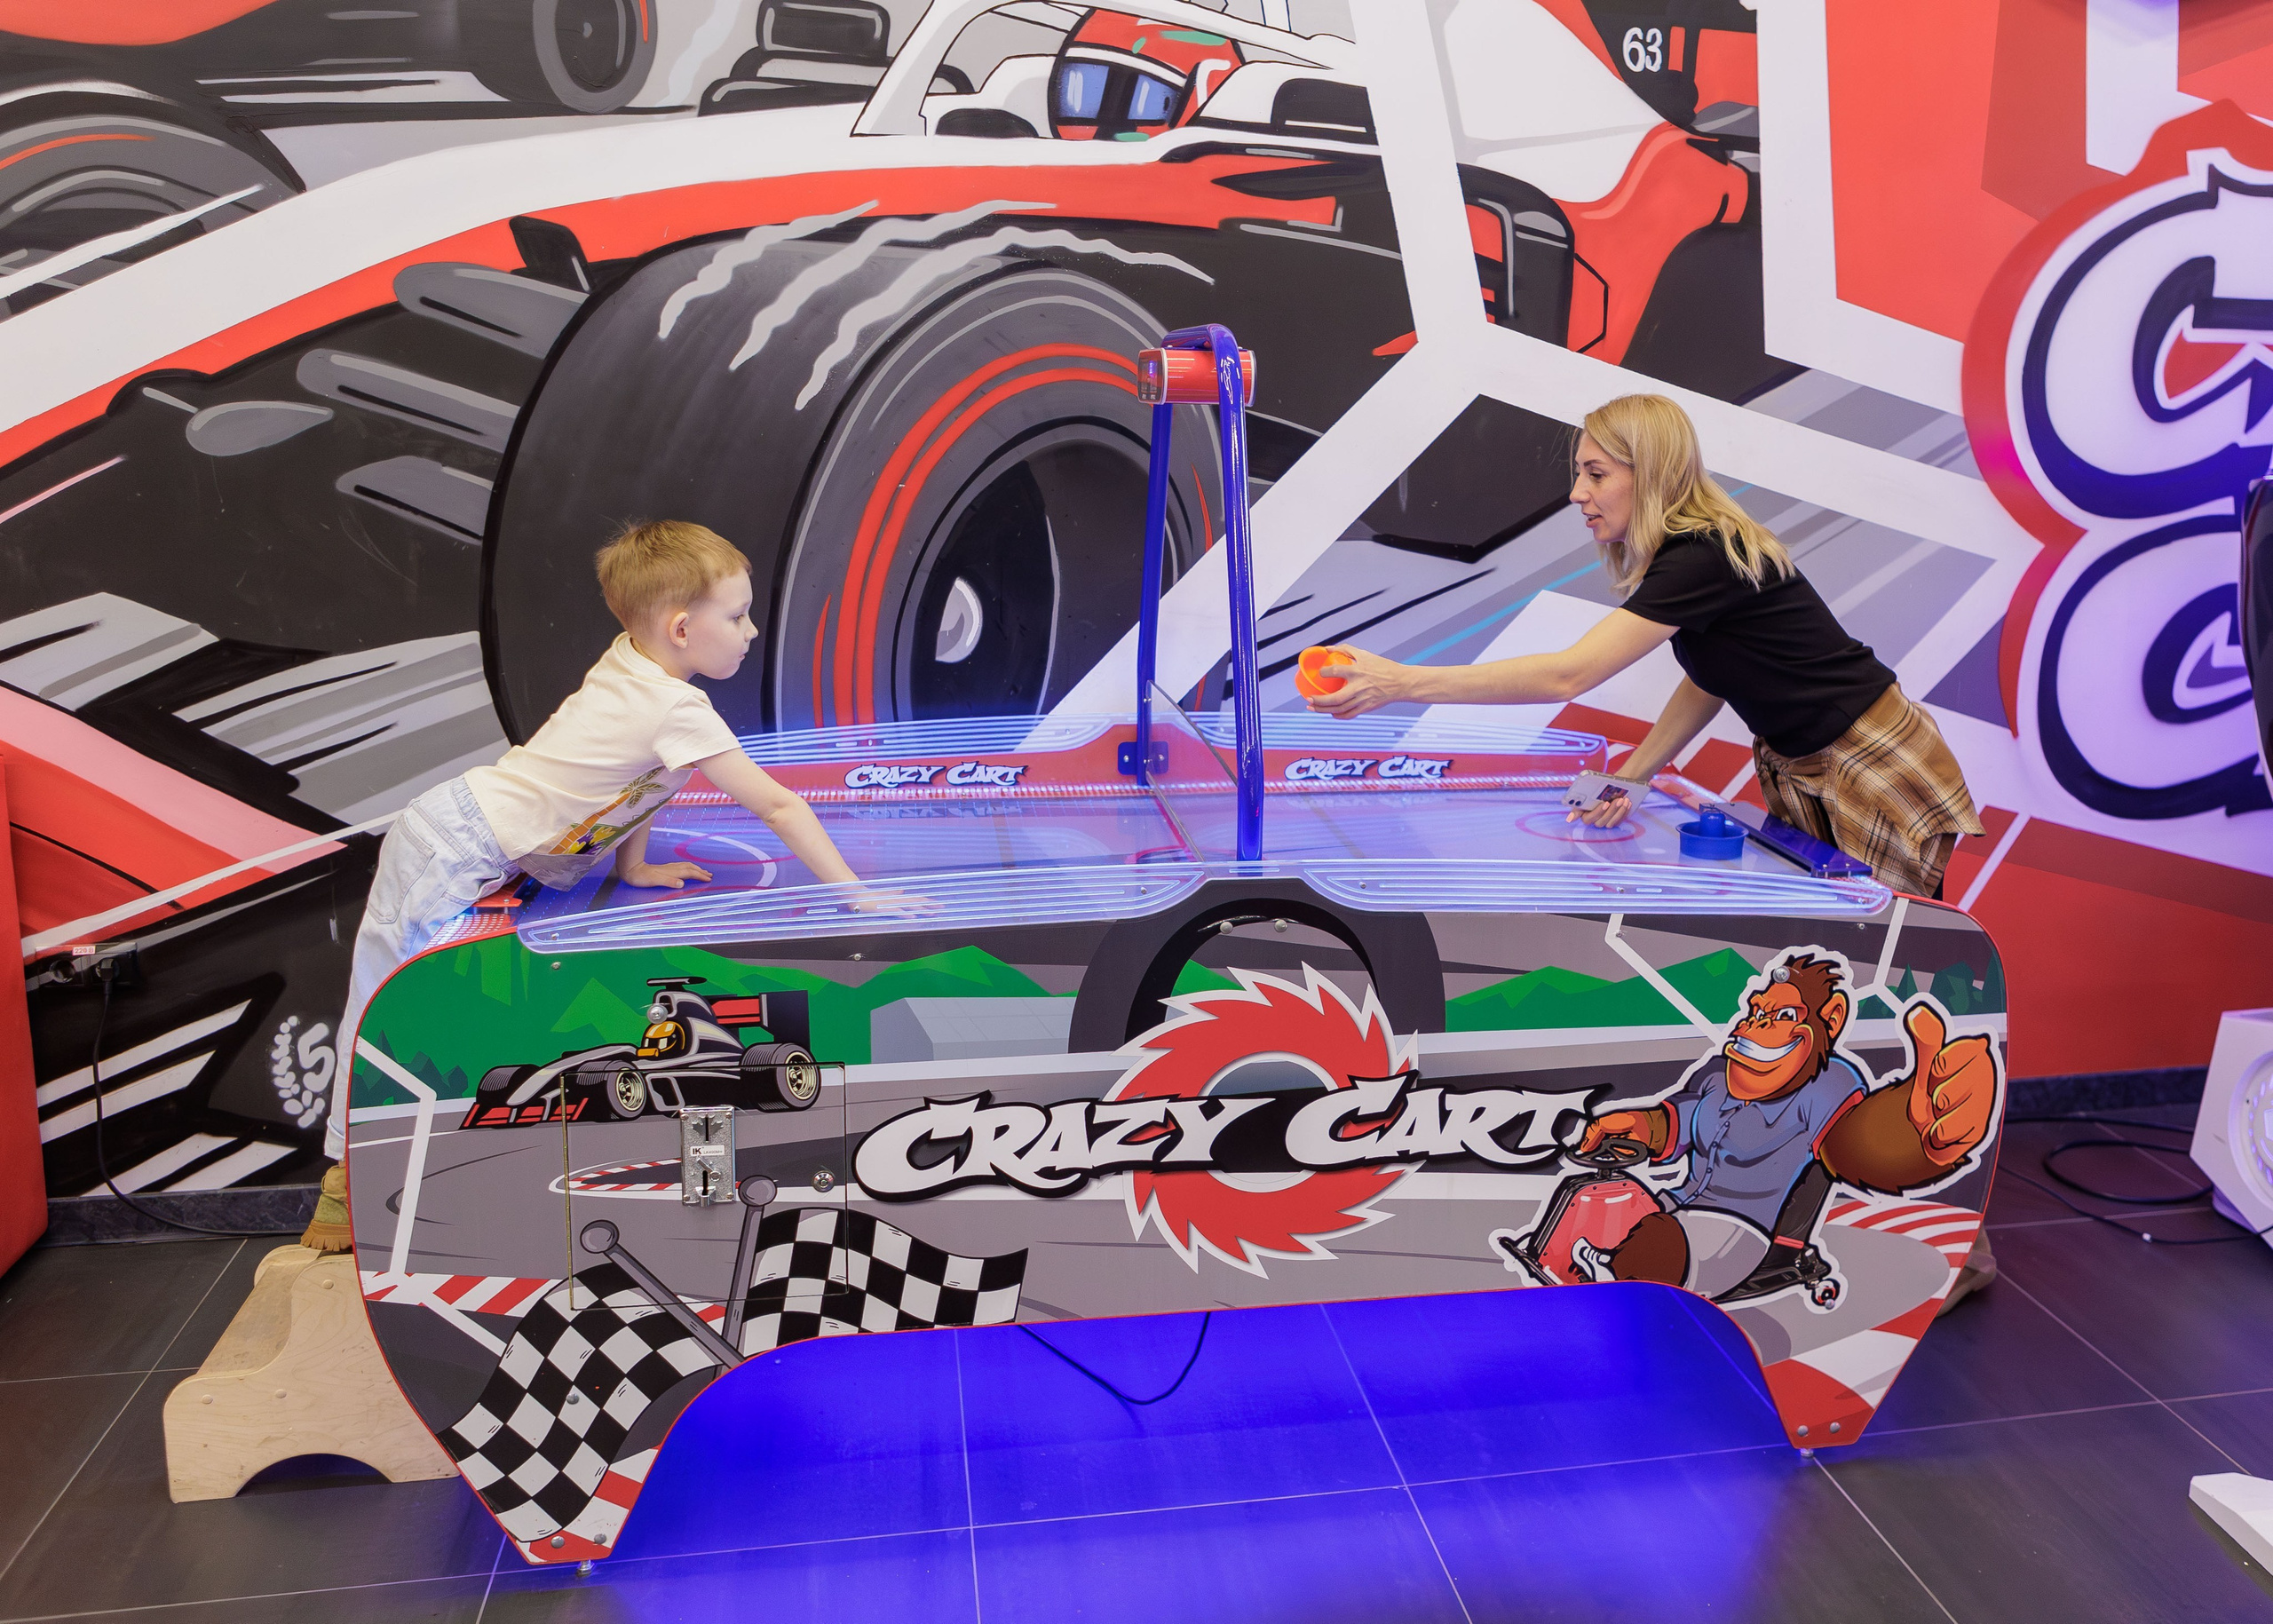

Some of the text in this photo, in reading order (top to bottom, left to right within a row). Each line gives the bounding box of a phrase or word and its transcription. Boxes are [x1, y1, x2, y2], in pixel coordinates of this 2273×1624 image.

[1623, 28, 1662, 72] 63
[844, 761, 1028, 788] CRAZY CART
[1284, 755, 1453, 780] CRAZY CART
[852, 1072, 1599, 1196] CRAZY CART
